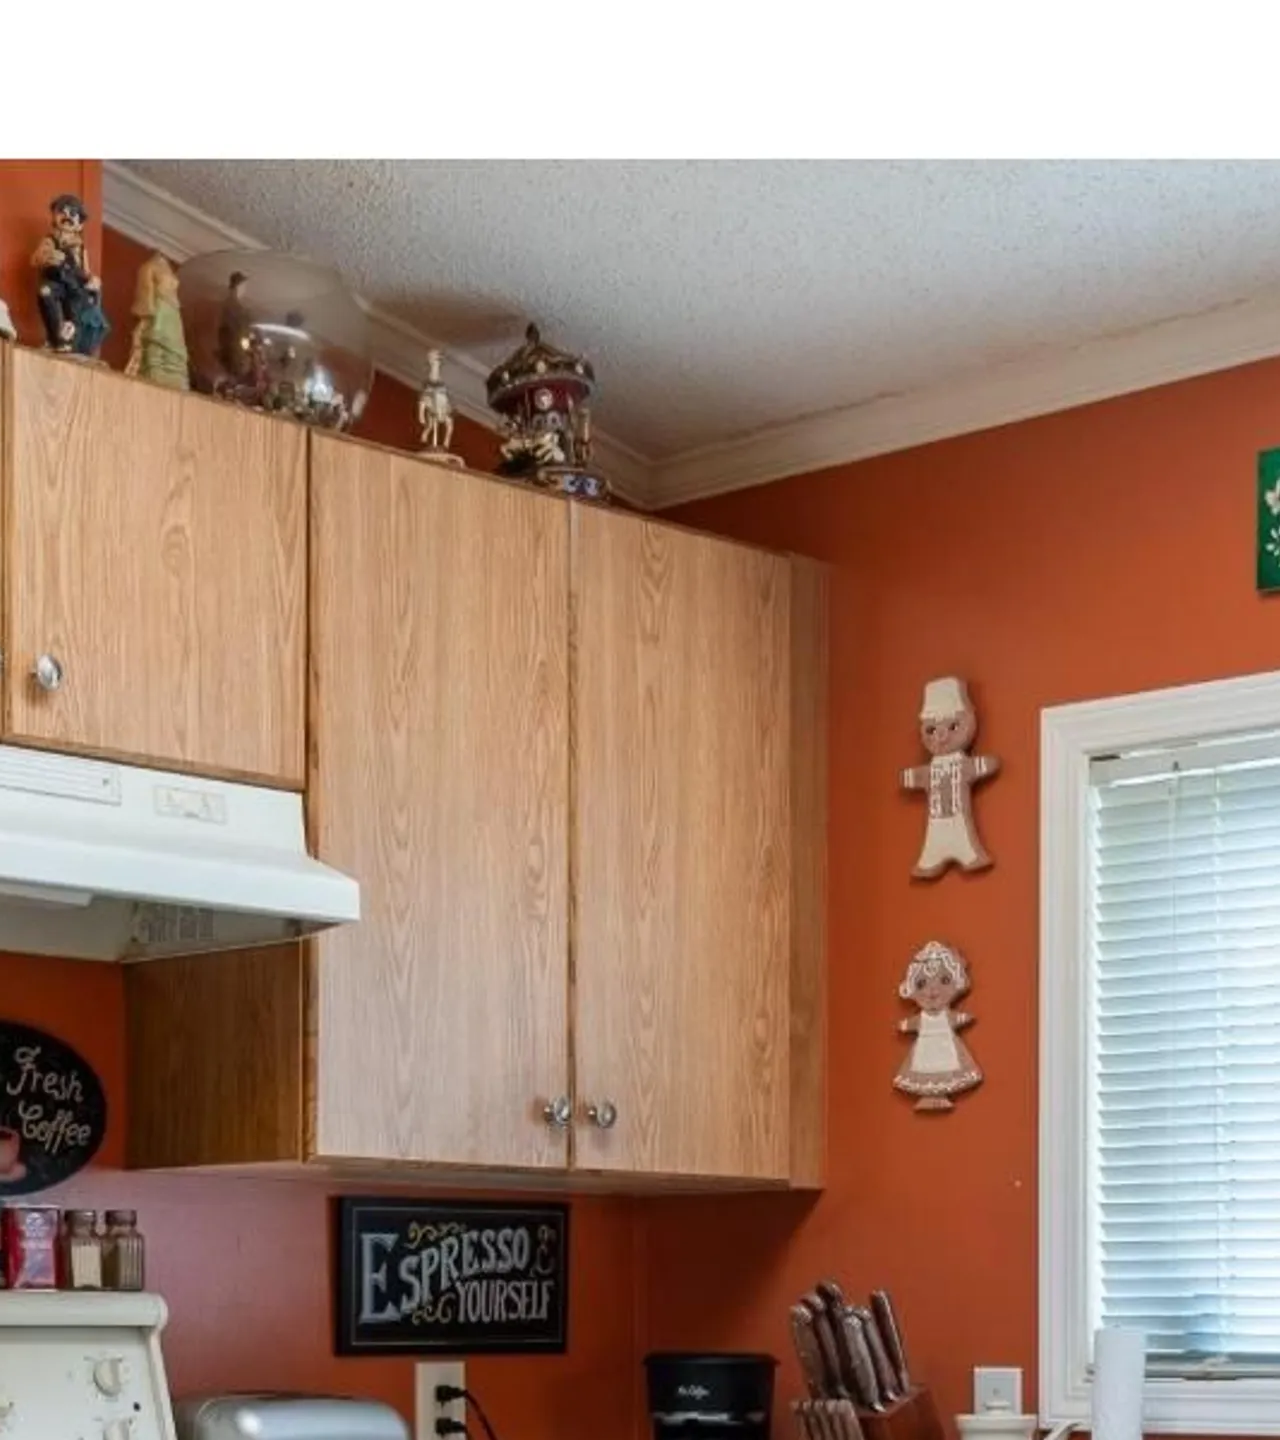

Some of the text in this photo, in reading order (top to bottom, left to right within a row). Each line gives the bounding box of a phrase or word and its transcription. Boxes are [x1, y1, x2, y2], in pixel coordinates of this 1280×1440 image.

[5, 1045, 84, 1103] Fresh
[18, 1100, 92, 1156] Coffee
[454, 1278, 556, 1324] YOURSELF
